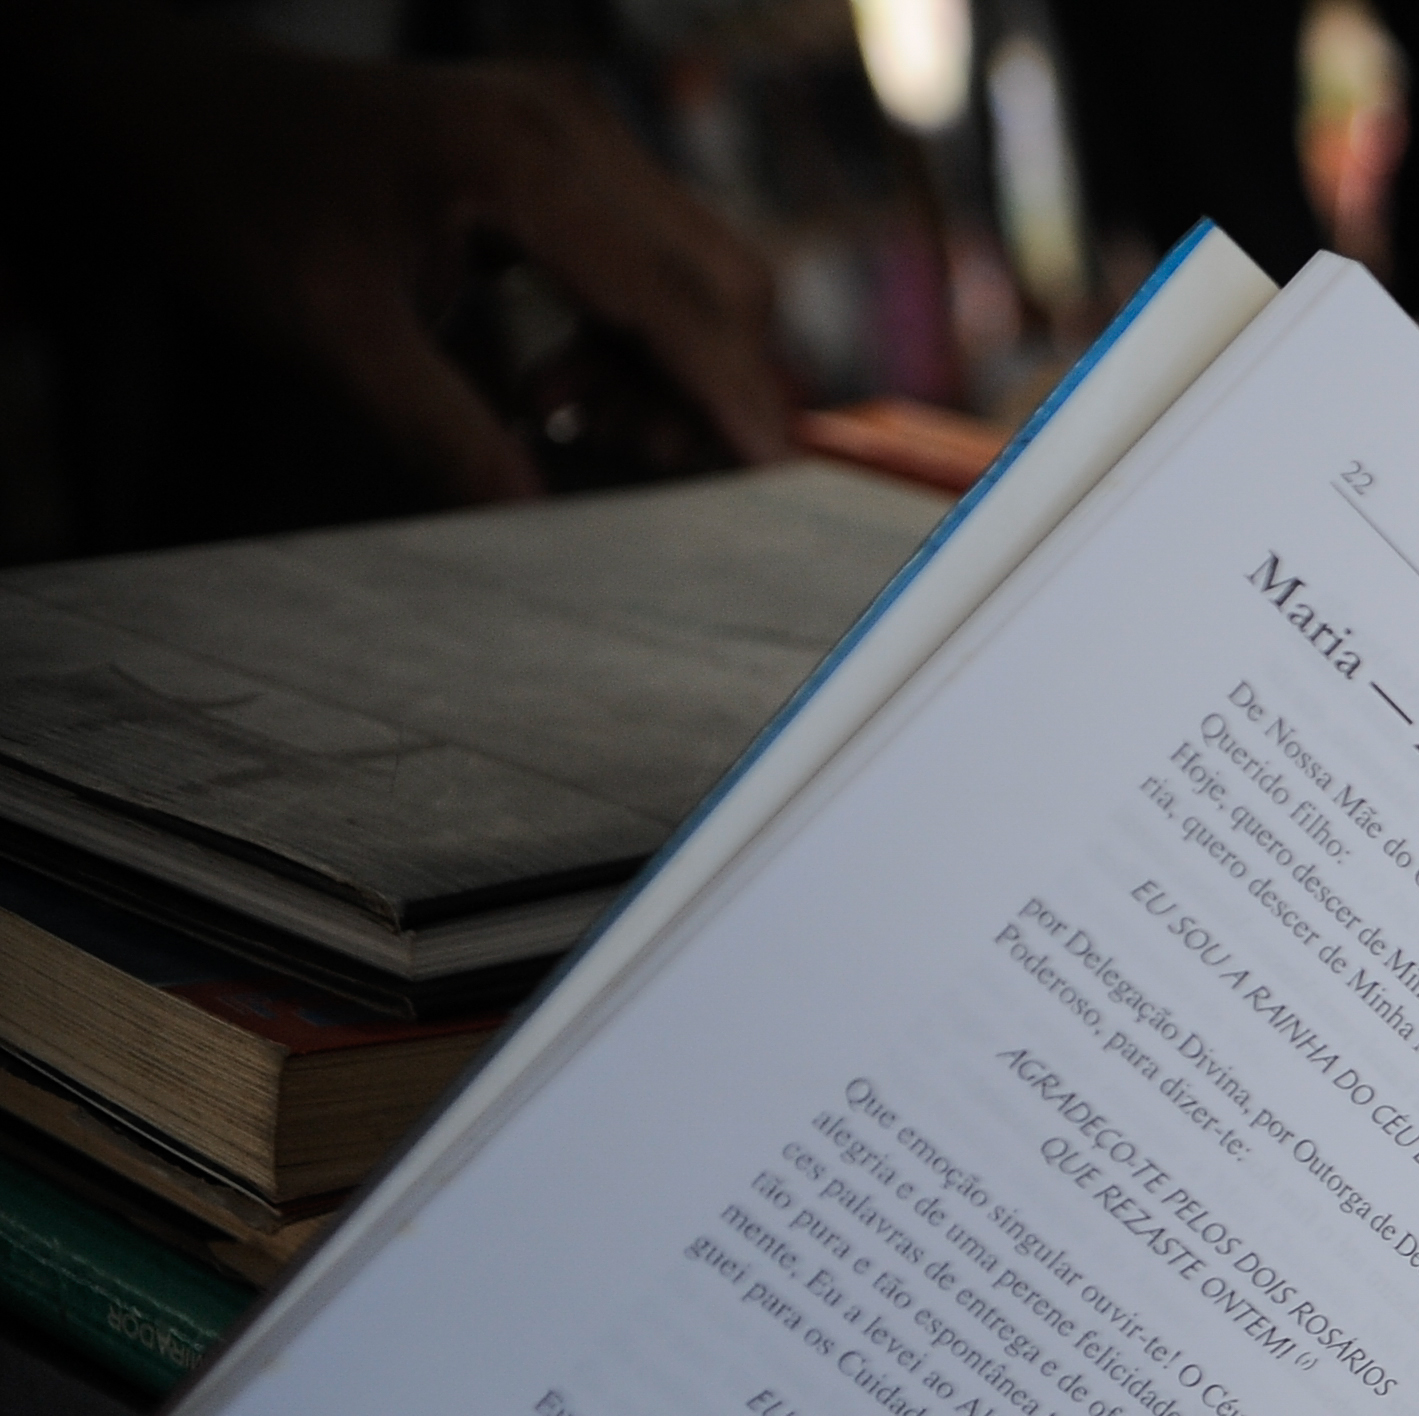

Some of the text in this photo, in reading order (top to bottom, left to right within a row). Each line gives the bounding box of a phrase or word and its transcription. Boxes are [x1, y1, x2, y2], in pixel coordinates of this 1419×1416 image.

[1339, 459, 1376, 496] 22
[1246, 551, 1362, 680] Maria
[1169, 741, 1226, 810] Hoje,
[1230, 805, 1294, 866] quero
[1291, 863, 1362, 930] descer
[1357, 926, 1387, 956] de
[1199, 711, 1351, 865] Querido filho:
[1226, 679, 1266, 722] De
[1263, 715, 1334, 792] Nossa
[1331, 783, 1383, 839] Mãe
[1382, 837, 1413, 868] do
[1129, 879, 1177, 915] EU
[1166, 916, 1231, 966] SOU
[1218, 969, 1251, 990] A
[1242, 984, 1340, 1074] RAINHA
[1331, 1067, 1376, 1105] DO
[995, 1048, 1398, 1396] AGRADEÇO-TE PELOS DOIS ROSÁRIOS
[1039, 1136, 1102, 1189] QUE
[1092, 1183, 1207, 1280] REZASTE
[1199, 1276, 1298, 1360] ONTEM!
